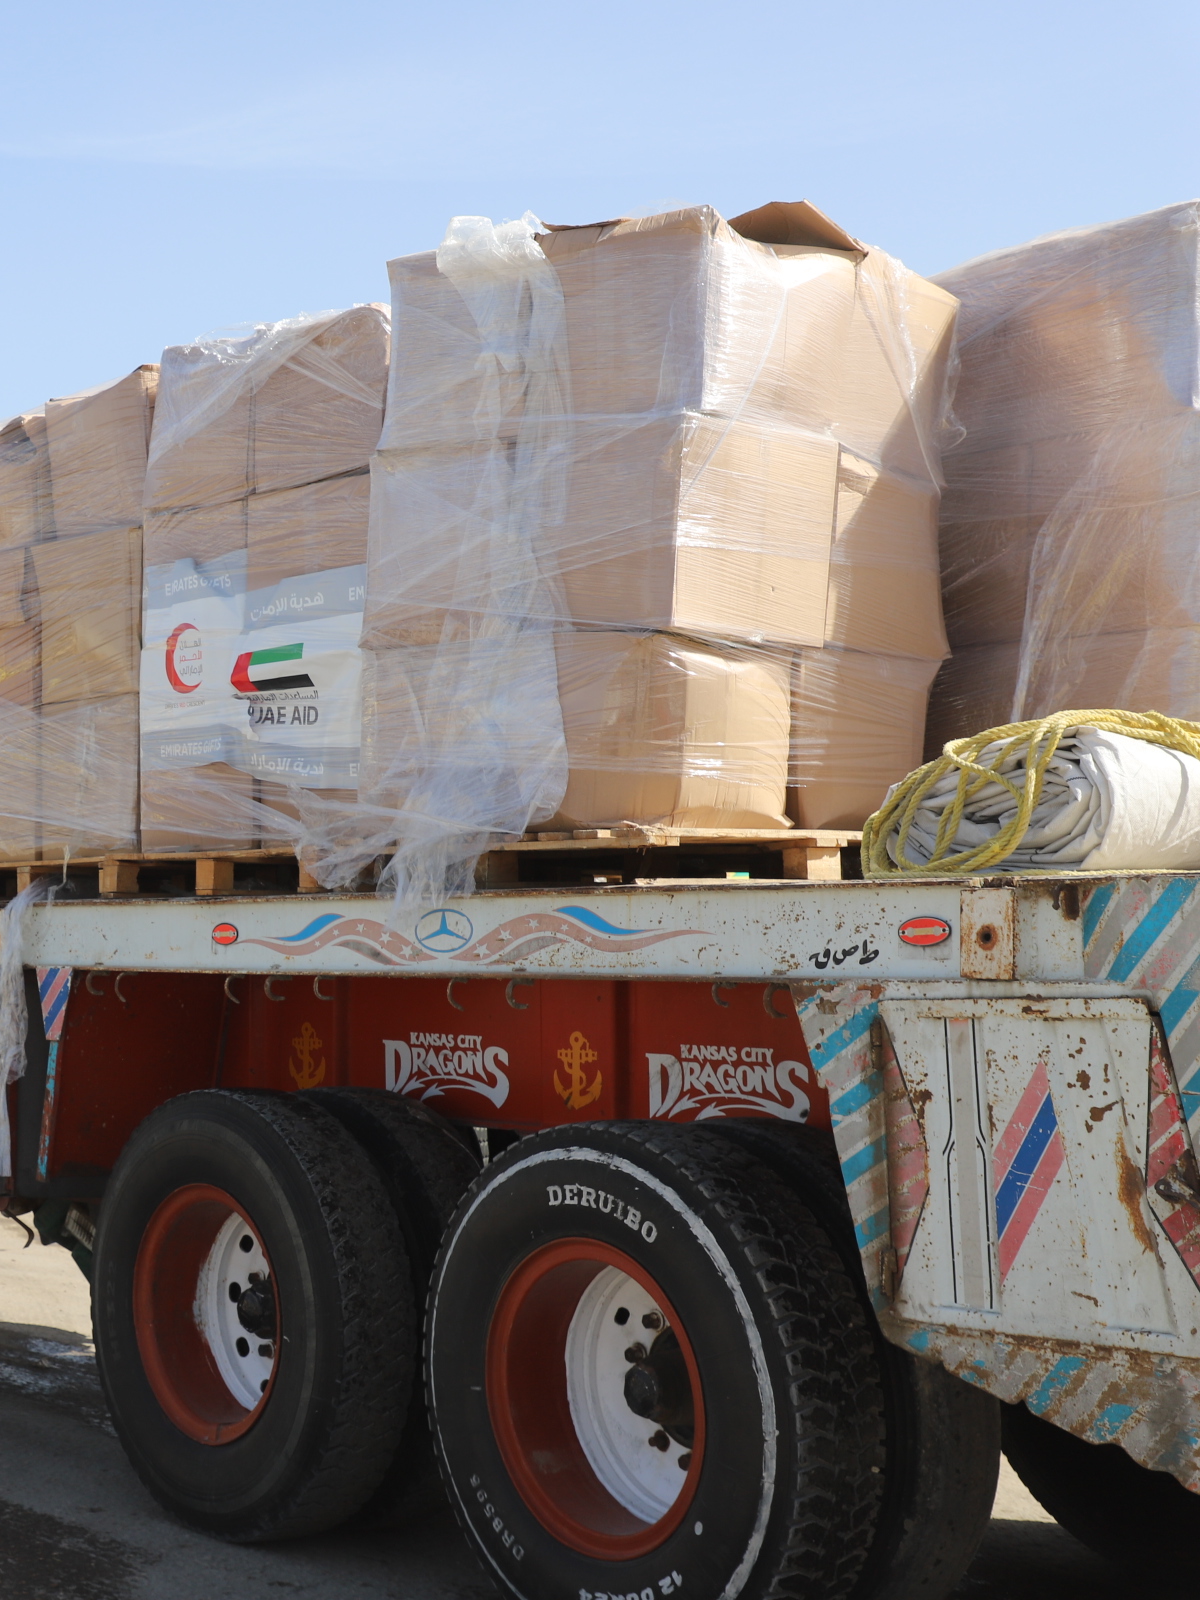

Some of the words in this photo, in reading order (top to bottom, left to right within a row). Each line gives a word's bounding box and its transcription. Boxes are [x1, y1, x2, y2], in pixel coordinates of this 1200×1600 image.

[290, 705, 319, 726] AID
[410, 1031, 455, 1050] KANSAS
[457, 1034, 483, 1052] CITY
[680, 1043, 738, 1065] KANSAS
[740, 1047, 774, 1066] CITY
[383, 1038, 510, 1109] DRAGONS
[645, 1052, 811, 1124] DRAGONS
[546, 1183, 658, 1245] DERUIBO
